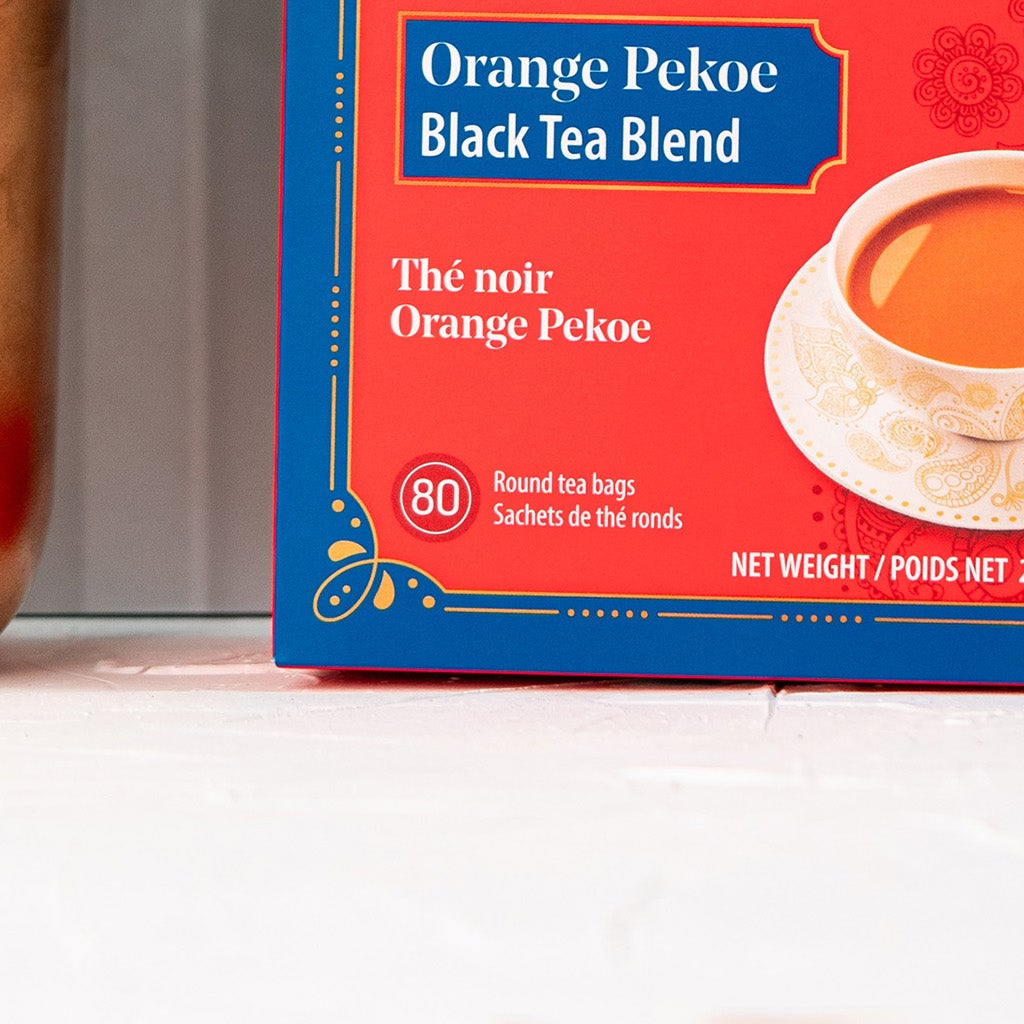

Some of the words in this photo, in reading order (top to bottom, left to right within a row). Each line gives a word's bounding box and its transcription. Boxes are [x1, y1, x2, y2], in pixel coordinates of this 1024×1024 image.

[422, 43, 608, 102] Orange
[624, 47, 777, 92] Pekoe
[422, 112, 528, 158] Black
[540, 115, 606, 160] Tea
[623, 116, 739, 162] Blend
[392, 258, 464, 292] Thé
[475, 262, 553, 293] noir
[391, 305, 527, 349] Orange
[539, 308, 651, 342] Pekoe
[411, 477, 461, 517] 80
[495, 471, 552, 493] Round
[558, 474, 586, 494] tea
[593, 473, 635, 501] bags
[494, 503, 563, 526] Sachets
[569, 505, 591, 526] de
[596, 506, 626, 527] thé
[632, 507, 682, 529] ronds
[732, 552, 774, 577] NET
[780, 553, 869, 579] WEIGHT
[874, 555, 885, 580] /
[892, 556, 958, 581] POIDS
[966, 557, 1008, 582] NET
